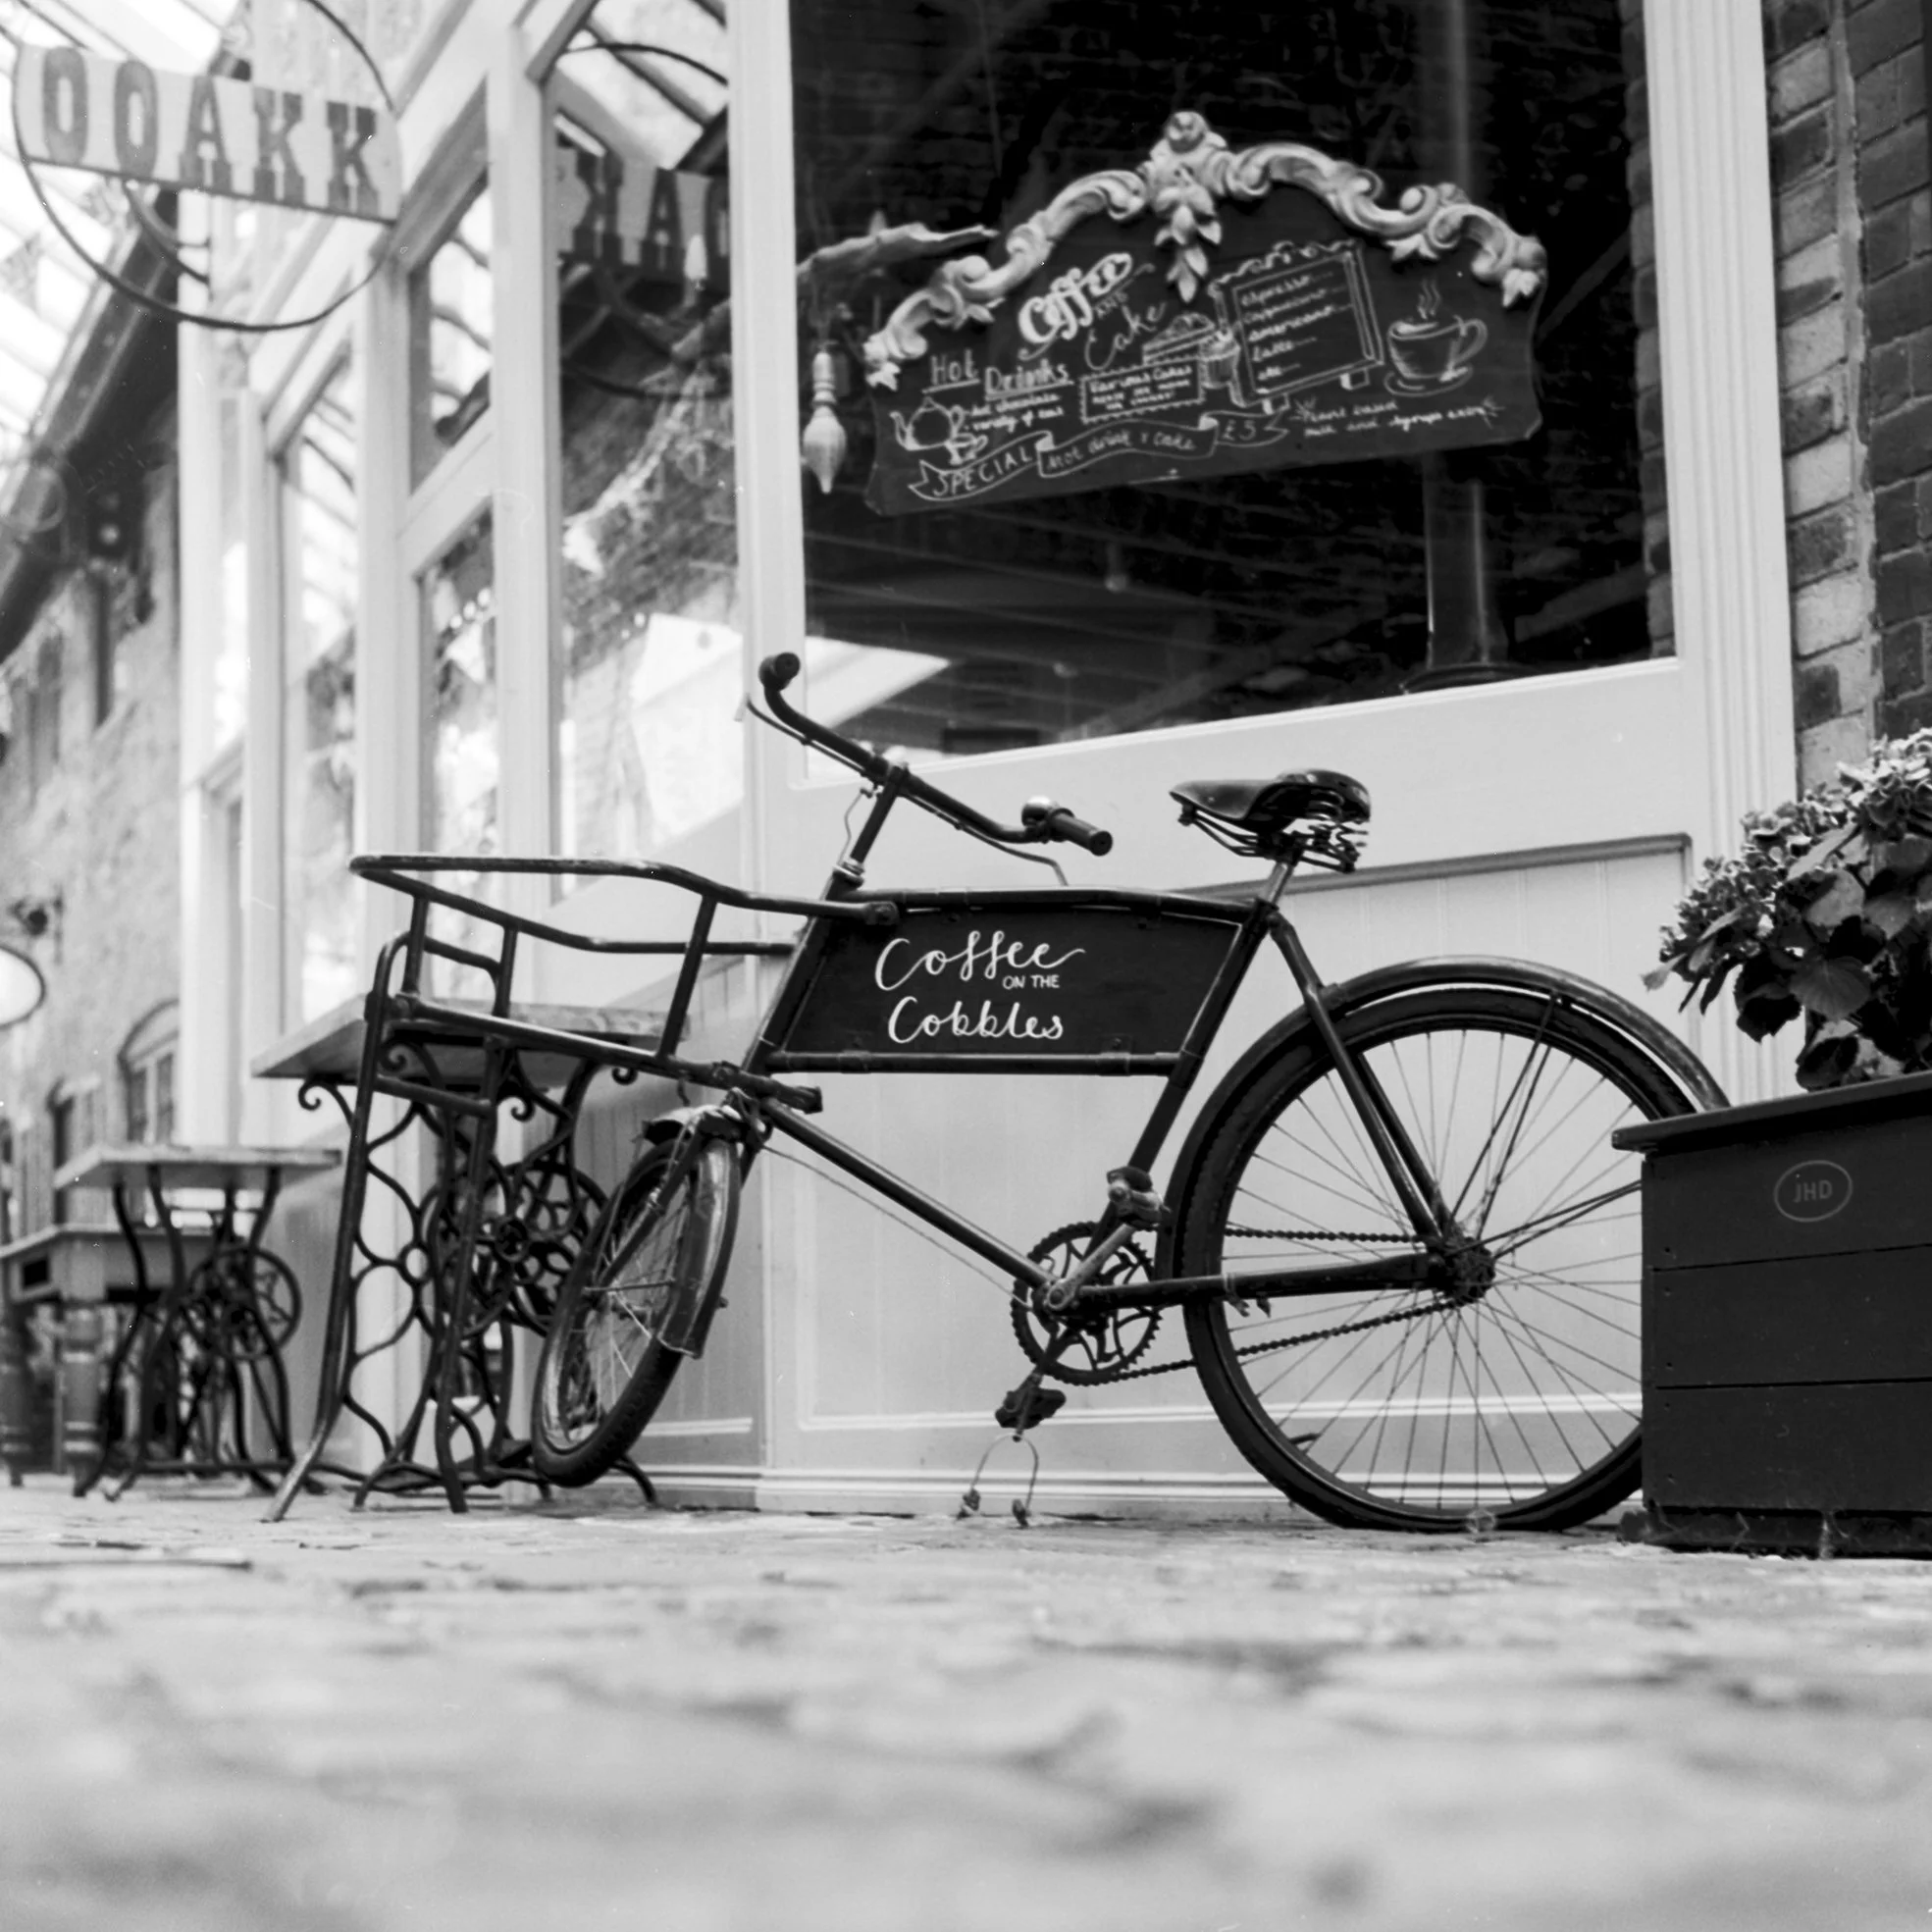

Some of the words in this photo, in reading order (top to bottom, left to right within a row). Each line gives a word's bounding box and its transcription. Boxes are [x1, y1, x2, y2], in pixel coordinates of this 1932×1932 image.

[42, 45, 379, 215] OOAKK
[930, 347, 978, 386] Hot
[984, 357, 1070, 394] Drinks
[932, 445, 1033, 496] SPECIAL
[874, 930, 1086, 991] Coffee
[1002, 975, 1026, 990] ON
[1029, 974, 1061, 989] THE
[888, 995, 1064, 1044] Cobbles
